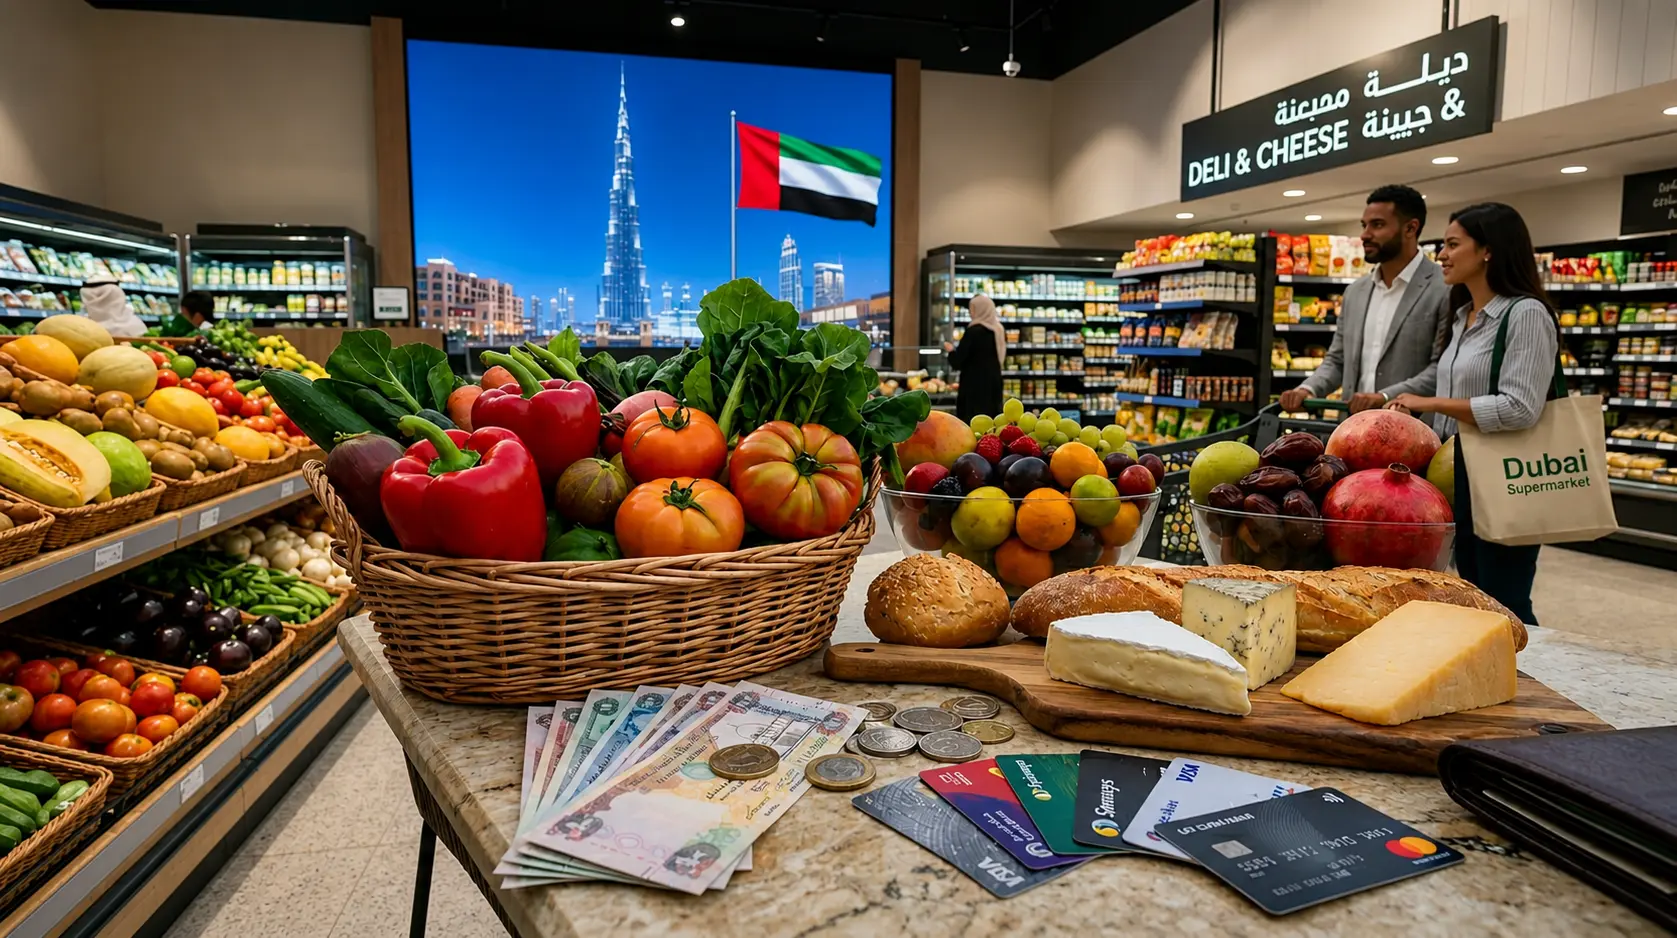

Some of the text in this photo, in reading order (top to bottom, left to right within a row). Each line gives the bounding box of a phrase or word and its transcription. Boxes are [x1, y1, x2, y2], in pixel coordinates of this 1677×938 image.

[1441, 87, 1466, 121] &
[1188, 119, 1350, 187] DELI & CHEESE
[1502, 448, 1588, 479] Dubai
[1507, 476, 1591, 496] Supermarket
[977, 856, 1025, 888] VISA
